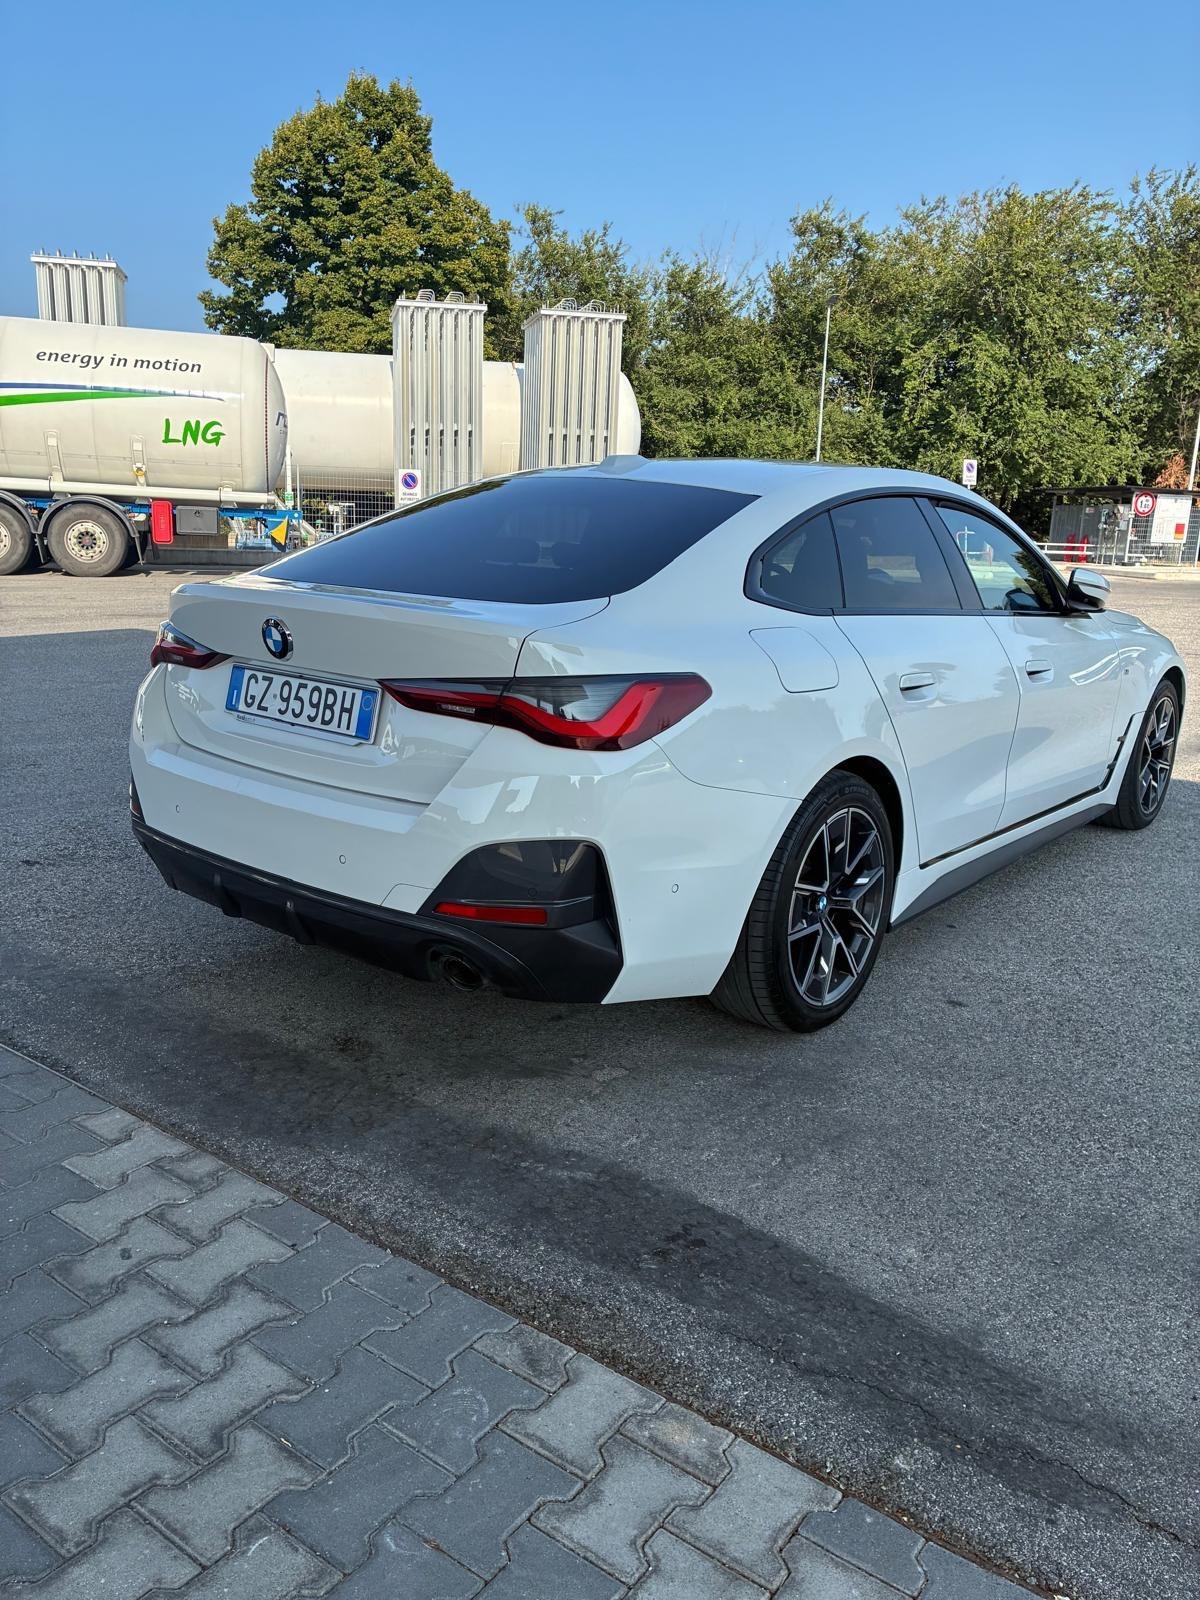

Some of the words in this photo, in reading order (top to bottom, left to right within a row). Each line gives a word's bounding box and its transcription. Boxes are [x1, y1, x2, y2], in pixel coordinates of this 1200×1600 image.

[36, 351, 104, 369] energy
[110, 354, 128, 368] in
[133, 359, 201, 373] motion
[162, 418, 226, 447] LNG
